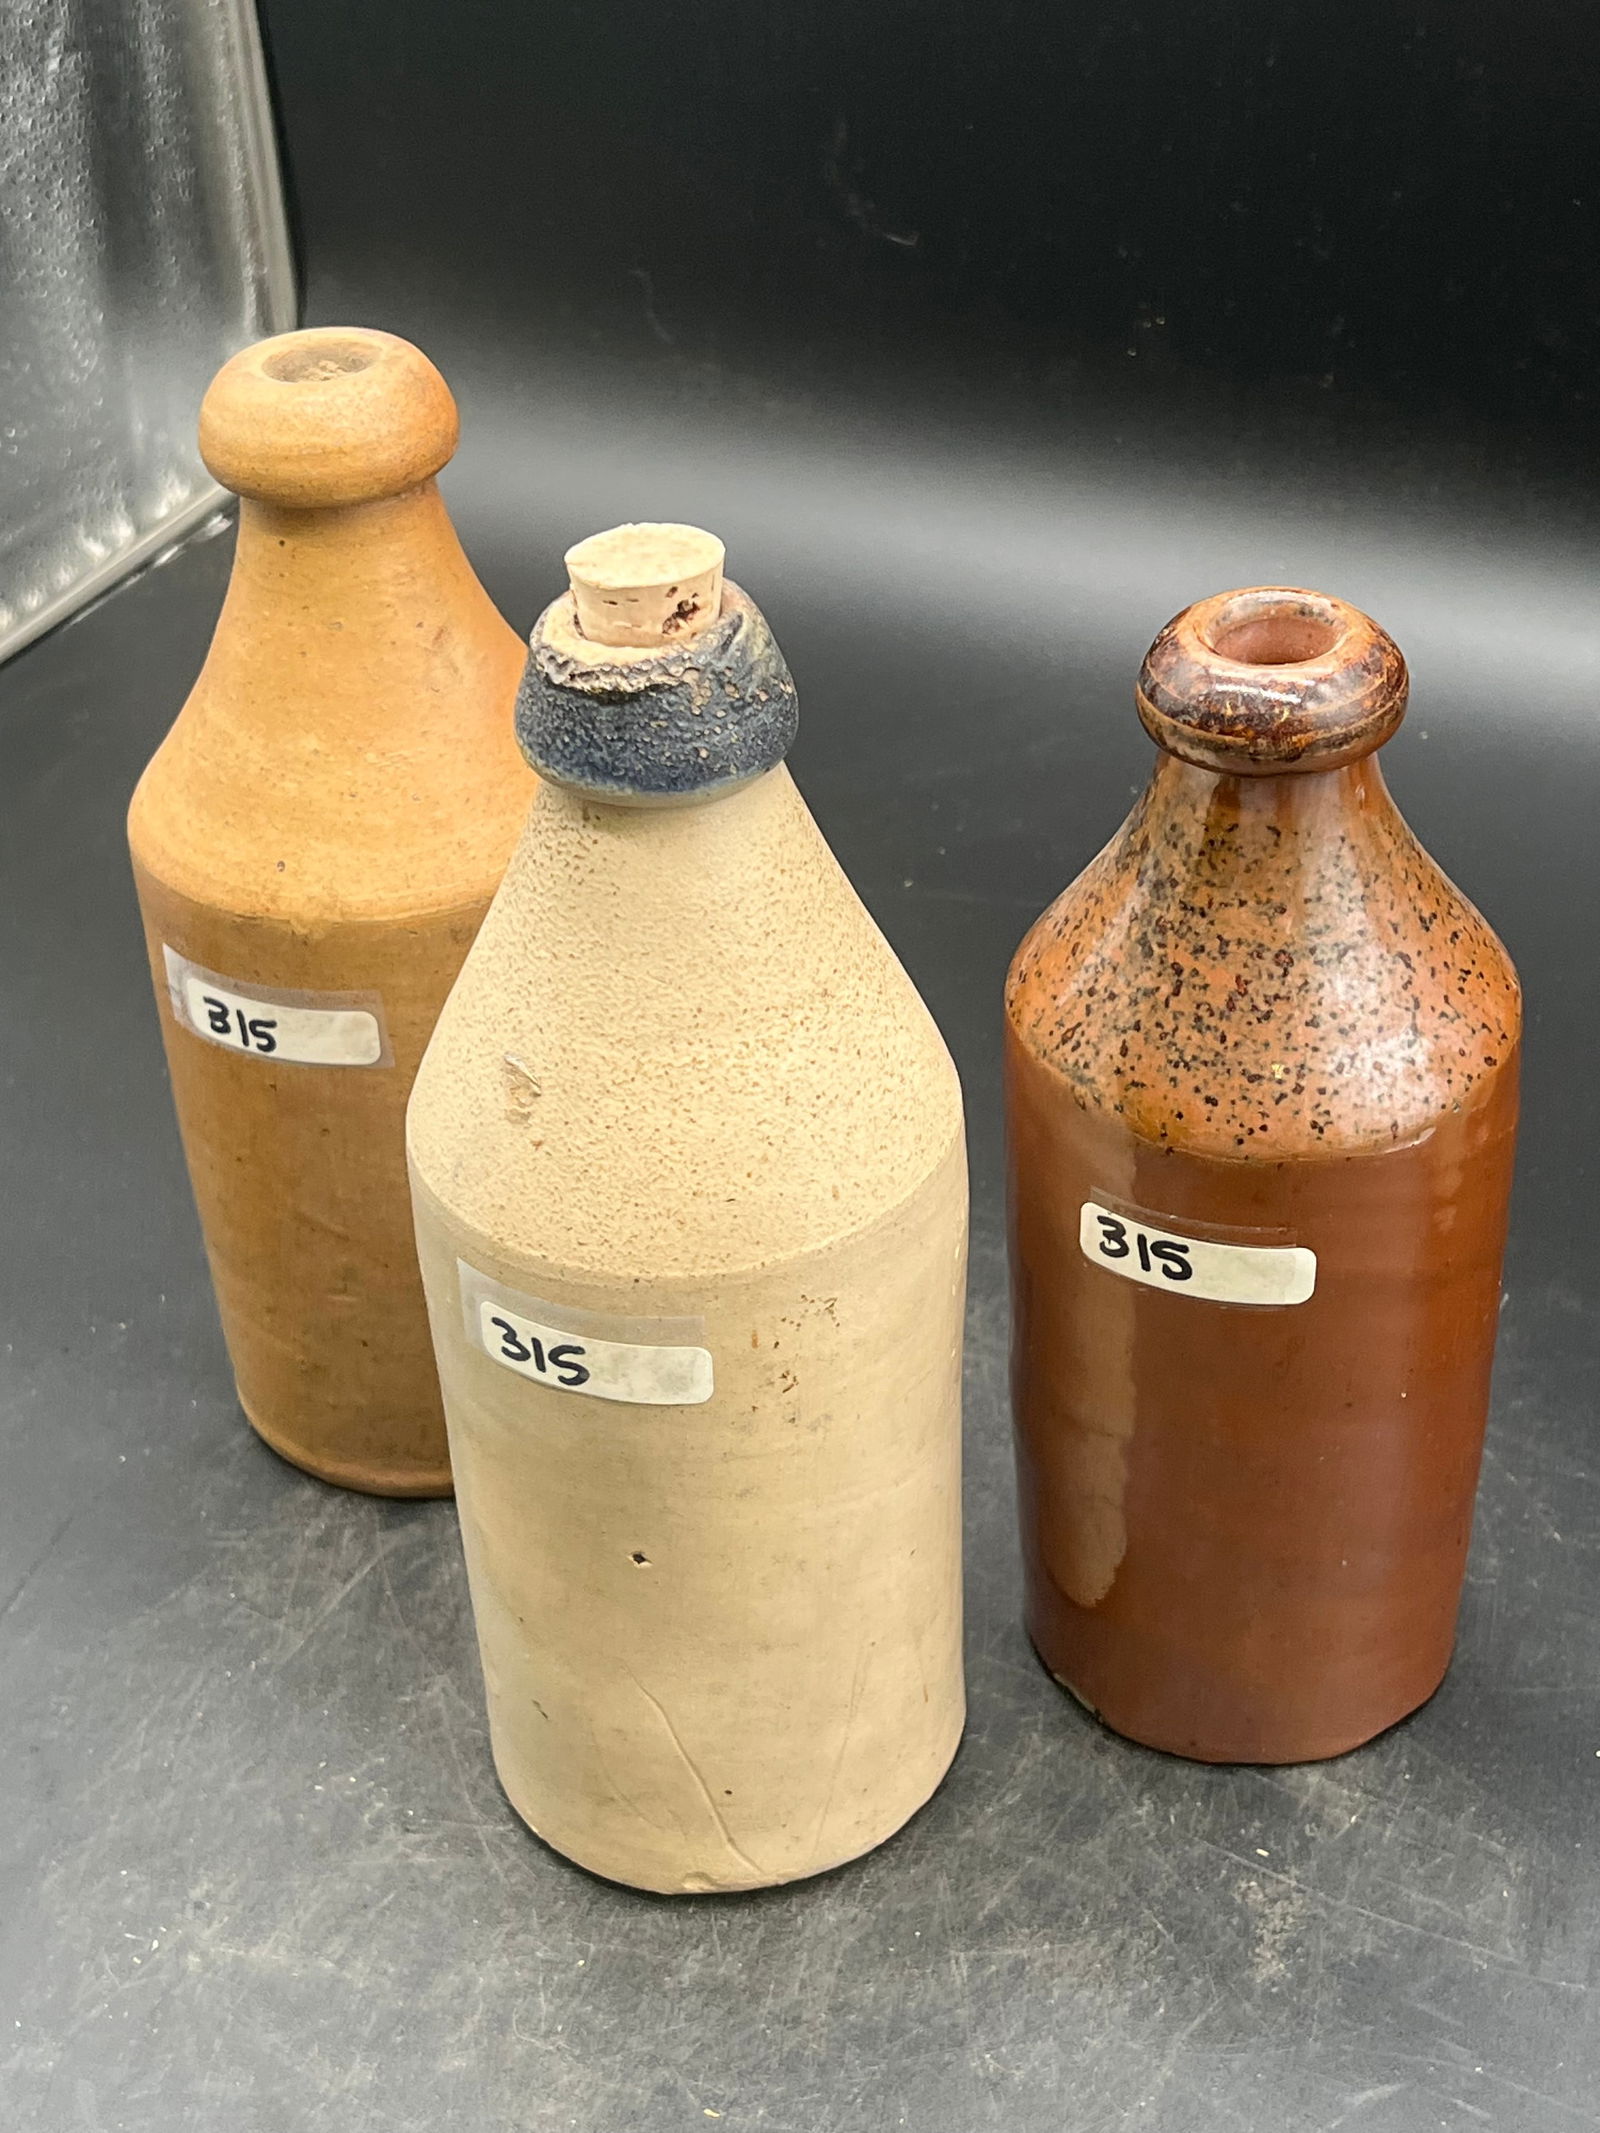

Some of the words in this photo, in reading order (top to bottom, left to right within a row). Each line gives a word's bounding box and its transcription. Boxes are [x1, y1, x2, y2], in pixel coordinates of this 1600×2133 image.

[203, 996, 278, 1053] 315
[1097, 1215, 1193, 1281] 315
[491, 1316, 590, 1386] 315
